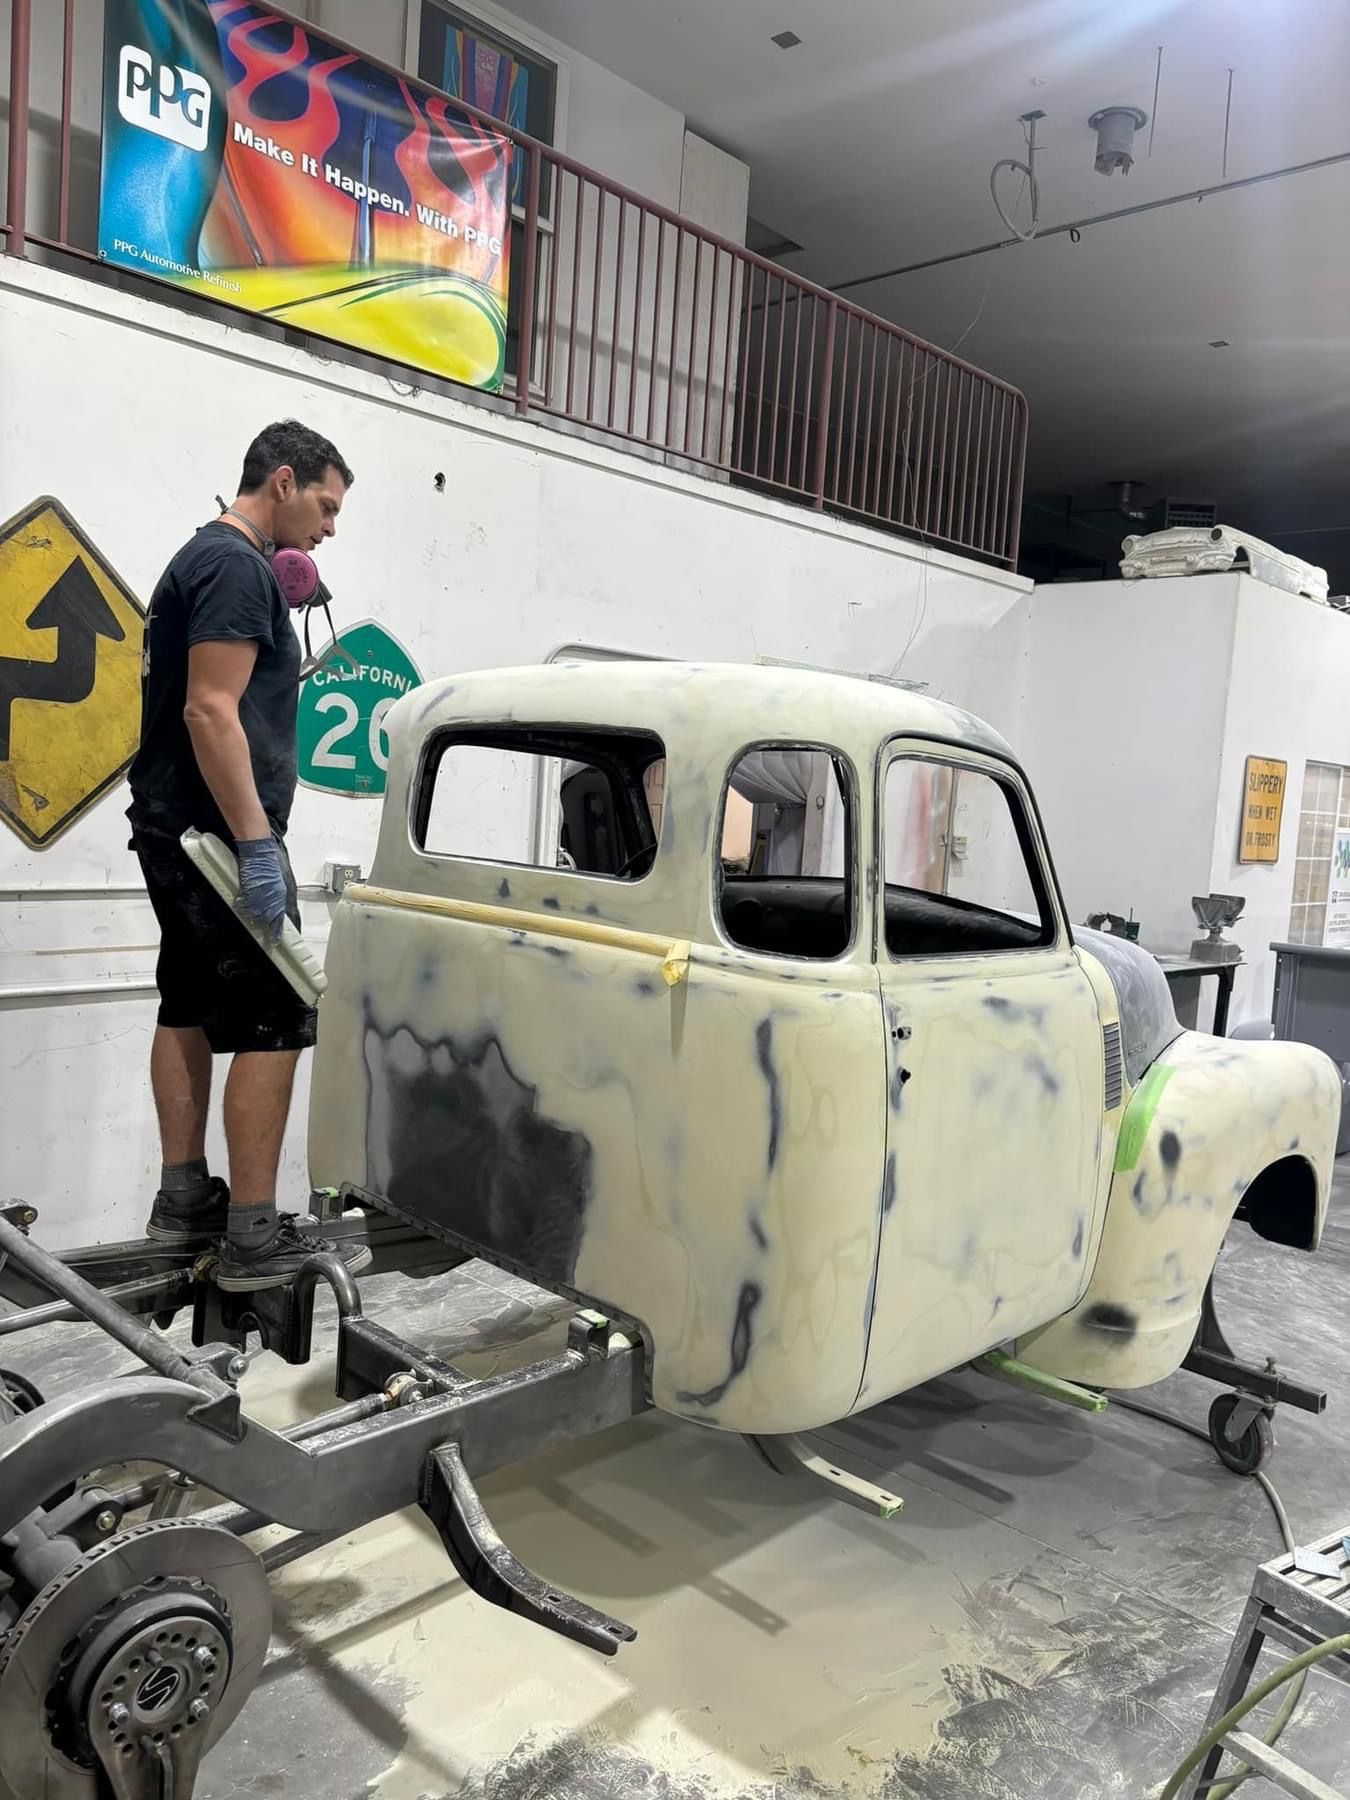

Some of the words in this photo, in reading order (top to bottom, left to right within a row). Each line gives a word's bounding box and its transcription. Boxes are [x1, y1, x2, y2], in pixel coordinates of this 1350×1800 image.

[125, 59, 205, 129] PPG
[233, 121, 295, 166] Make
[302, 153, 318, 177] It
[325, 164, 410, 217] Happen.
[416, 203, 458, 238] With
[464, 225, 502, 256] PPG
[114, 239, 138, 257] PPG
[140, 249, 201, 278] Automotive
[203, 270, 242, 293] Refinish
[313, 664, 412, 694] CALIFORNI
[1249, 772, 1283, 794] SLIPPERY
[1248, 804, 1263, 819] WHEN
[1265, 806, 1278, 821] WET
[1254, 832, 1276, 848] FROSTY
